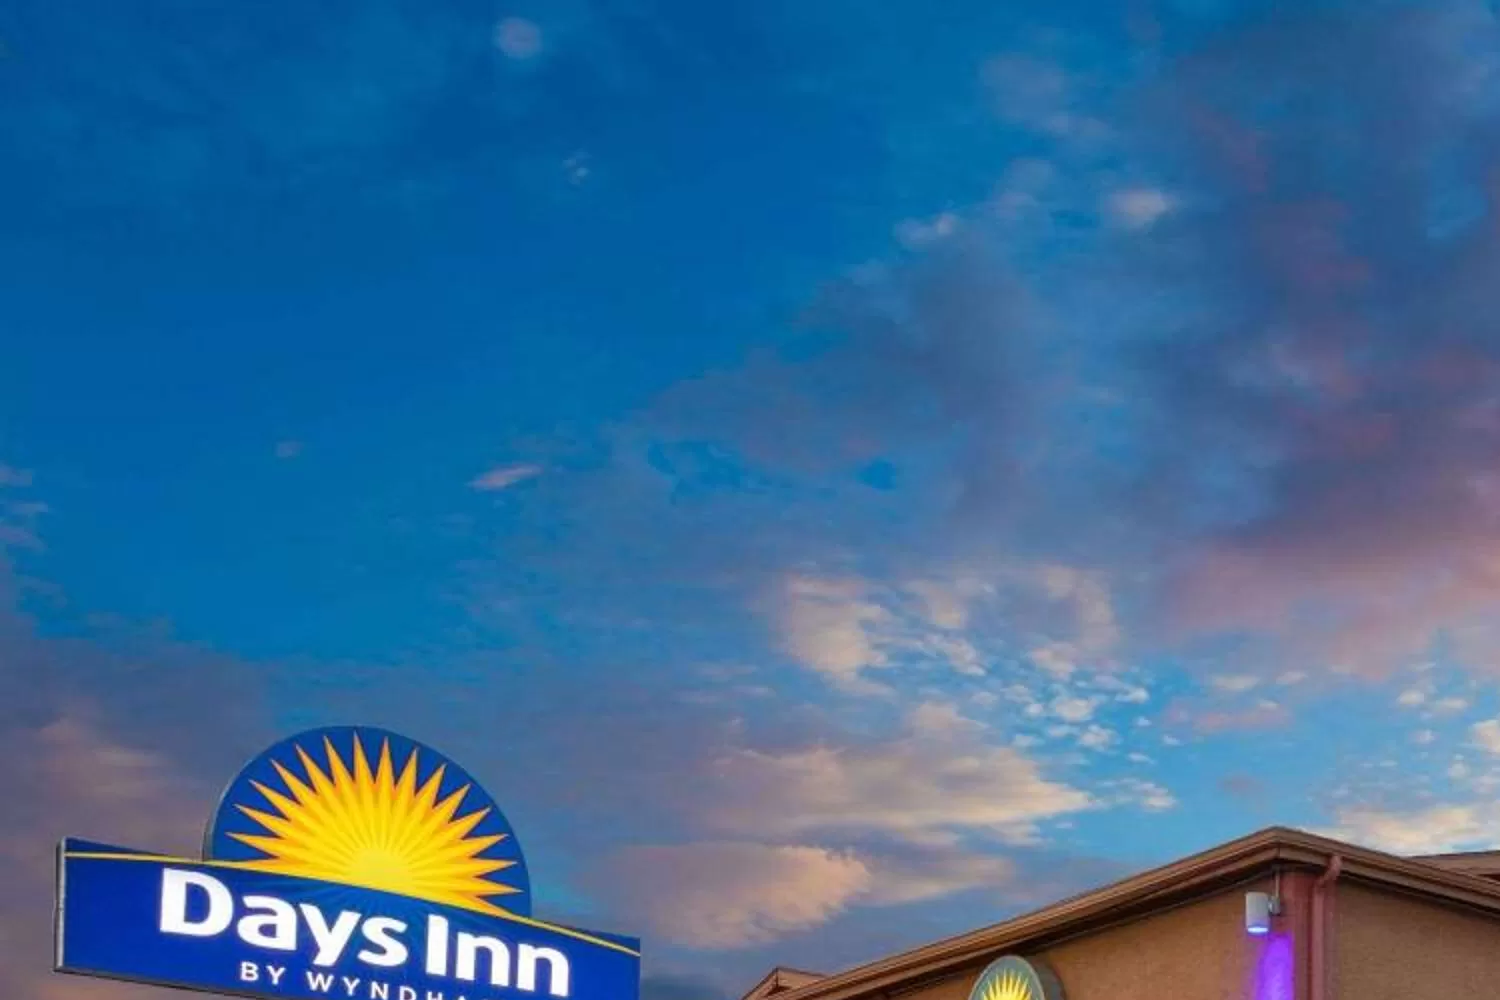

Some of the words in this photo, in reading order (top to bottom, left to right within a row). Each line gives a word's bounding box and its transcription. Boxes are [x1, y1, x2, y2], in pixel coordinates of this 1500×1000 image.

[160, 867, 409, 967] Days
[426, 913, 570, 998] Inn
[239, 961, 286, 985] BY
